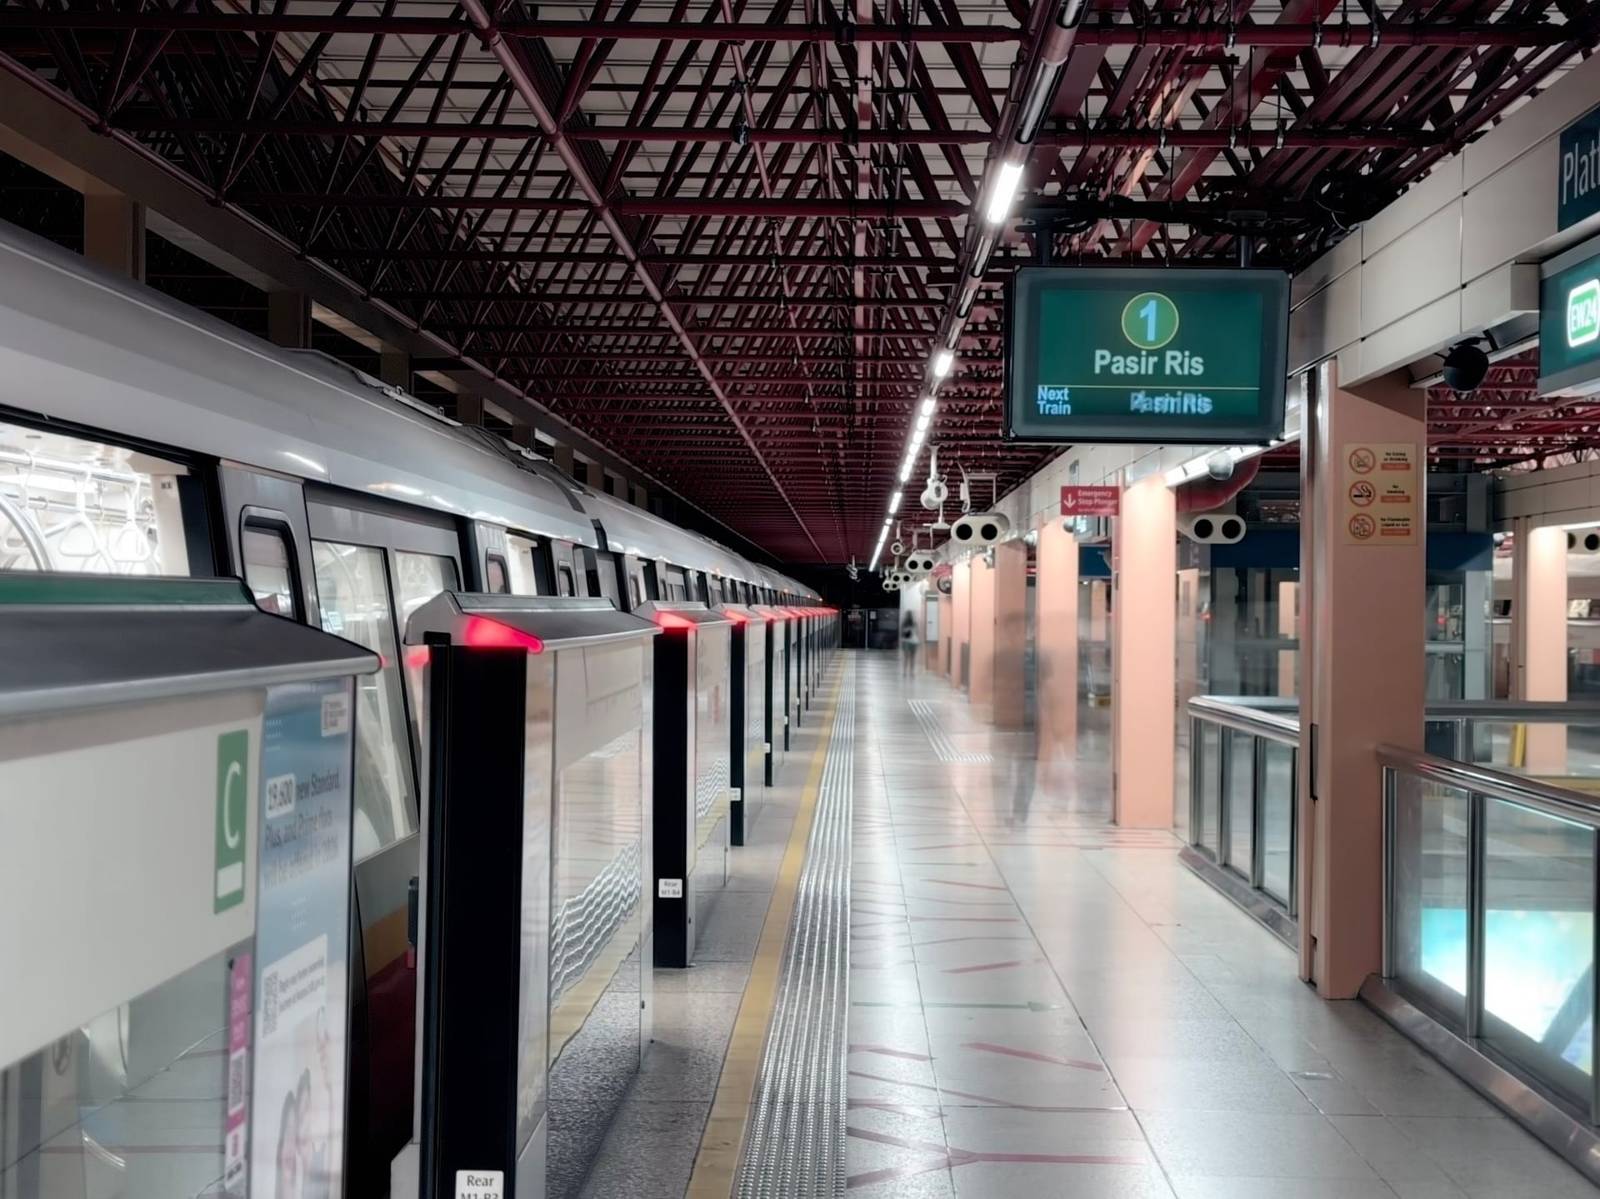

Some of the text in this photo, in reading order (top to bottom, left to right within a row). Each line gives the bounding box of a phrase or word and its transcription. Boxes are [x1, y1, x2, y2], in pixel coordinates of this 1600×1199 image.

[1139, 299, 1157, 342] 1
[1094, 349, 1204, 376] Pasir Ris
[1037, 386, 1069, 401] Next
[1037, 401, 1072, 415] Train
[1078, 490, 1112, 498] Emergency
[467, 1174, 494, 1187] Rear
